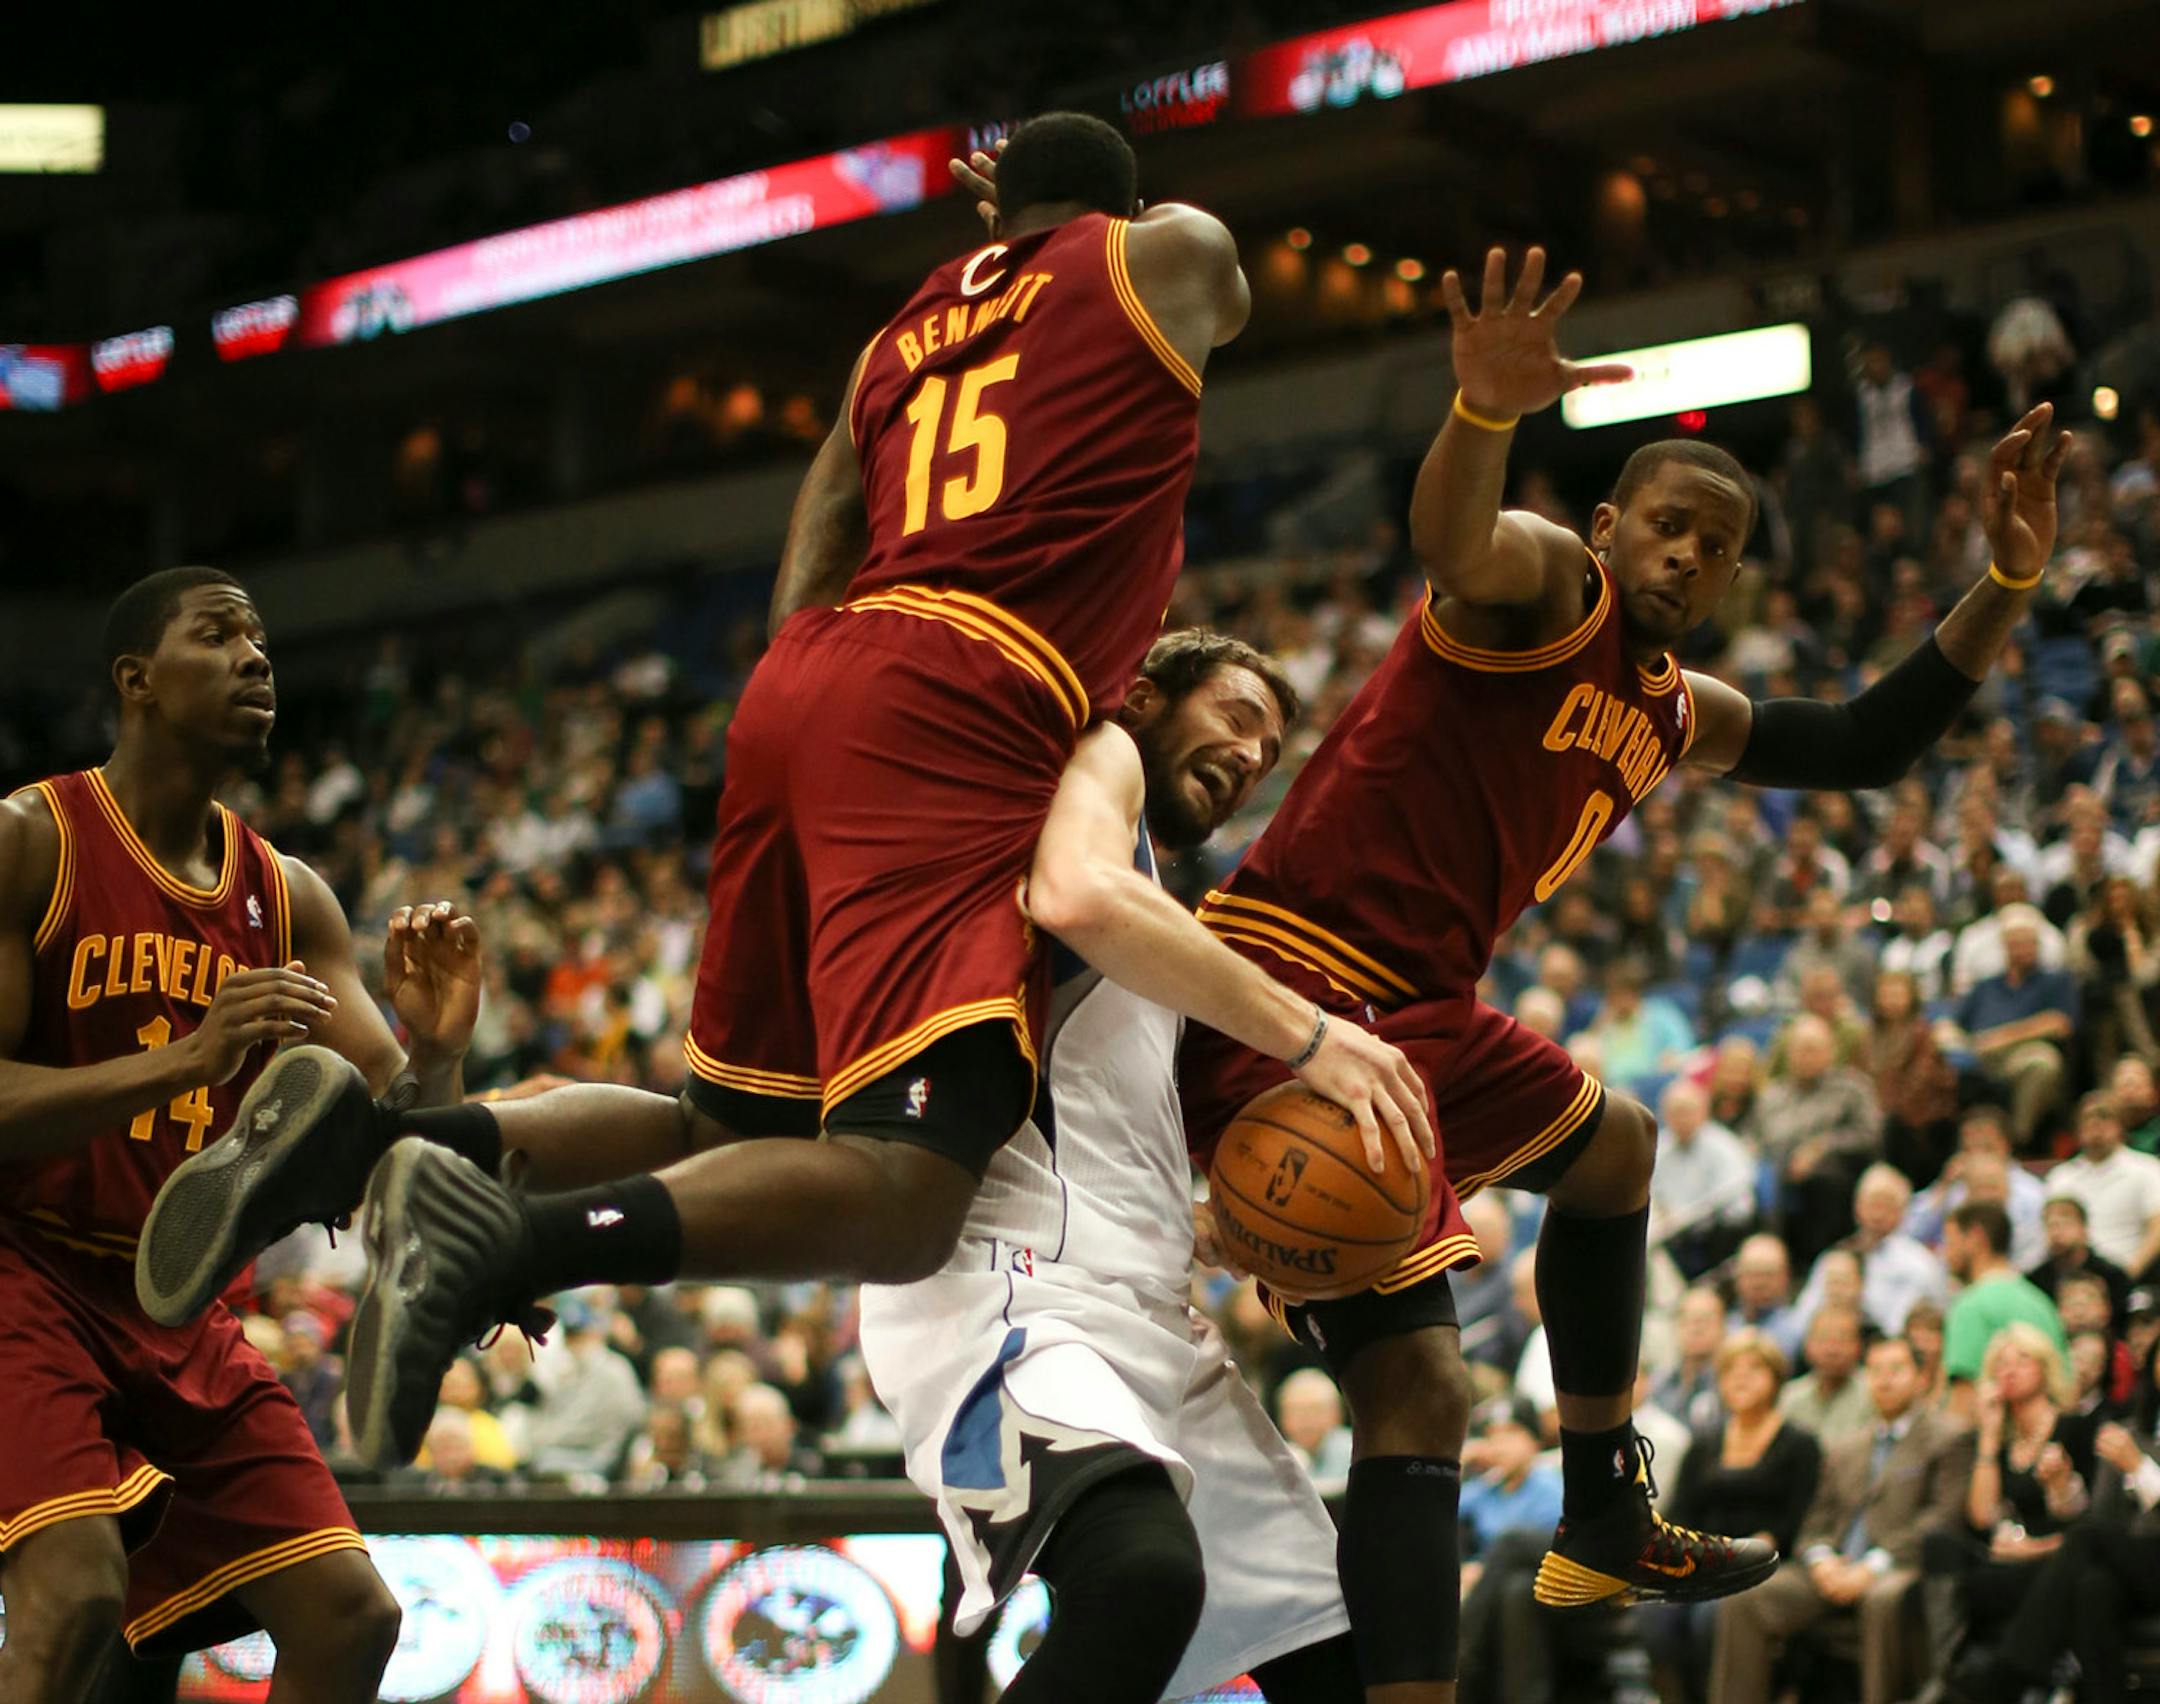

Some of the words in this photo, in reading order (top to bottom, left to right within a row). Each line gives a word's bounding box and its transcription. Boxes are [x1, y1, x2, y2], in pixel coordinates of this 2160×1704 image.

[902, 353, 1021, 538] 15
[1534, 789, 1614, 904] 0
[66, 932, 250, 1010] CLEVELA
